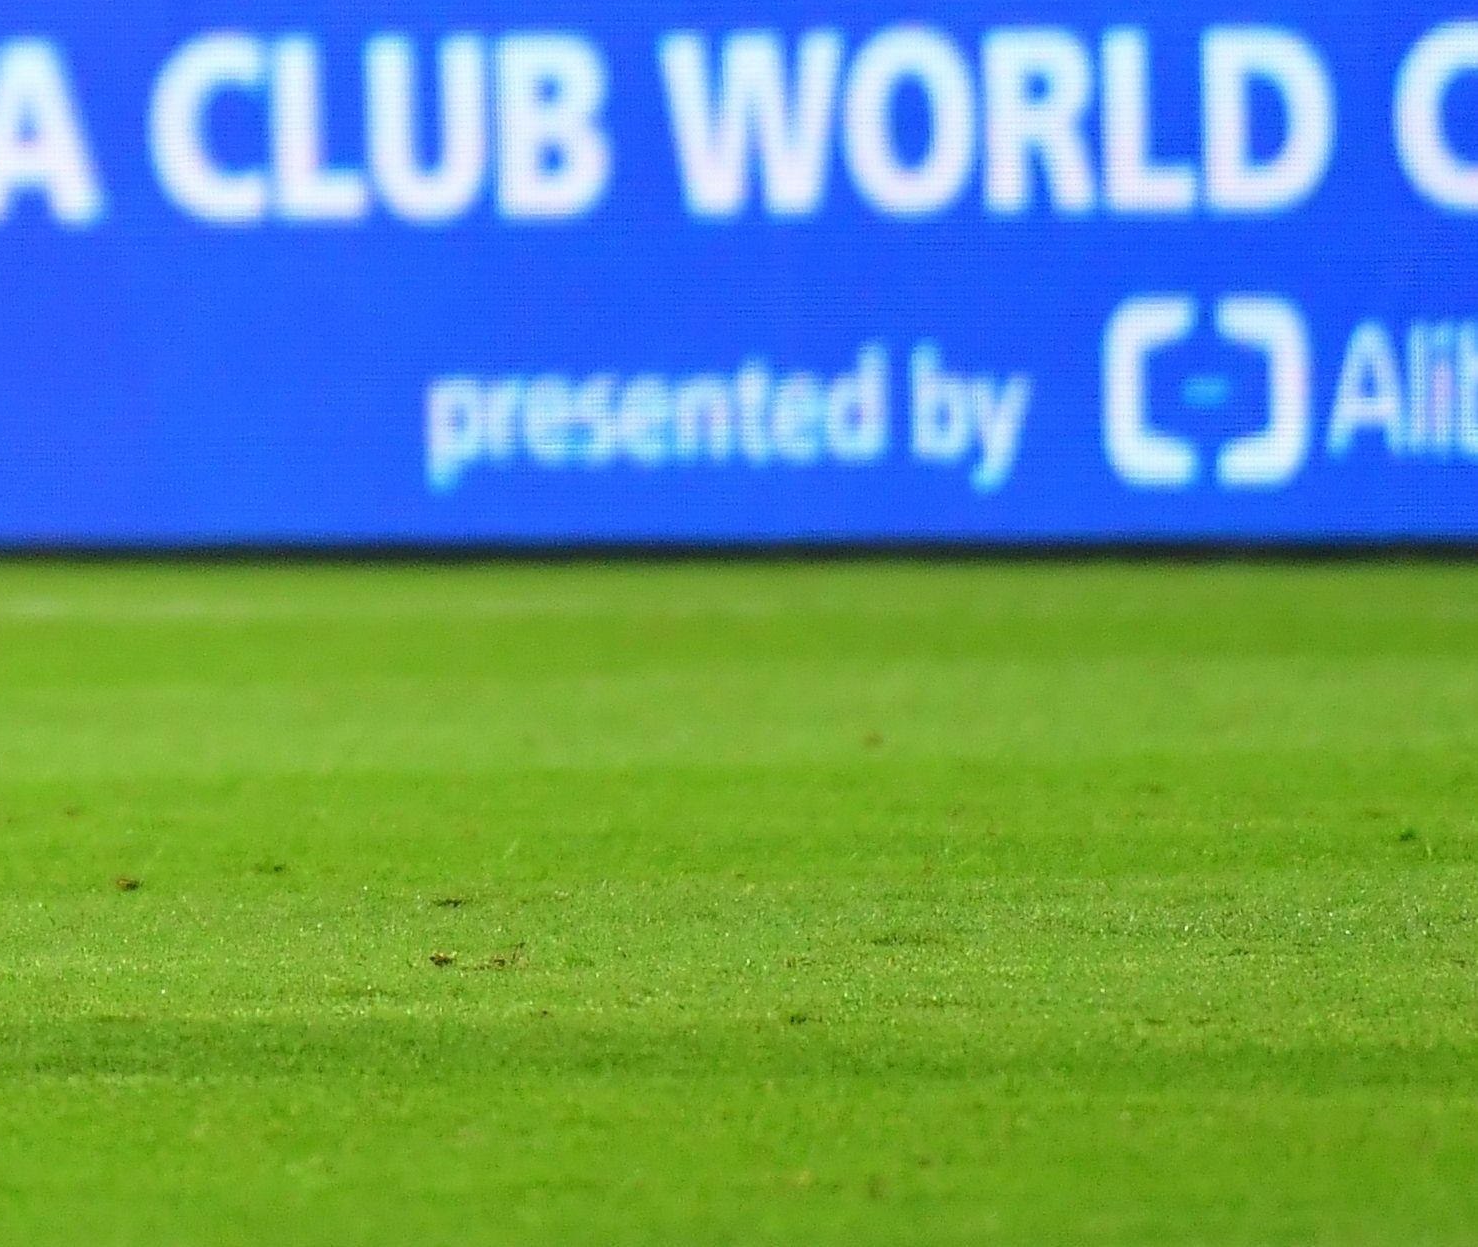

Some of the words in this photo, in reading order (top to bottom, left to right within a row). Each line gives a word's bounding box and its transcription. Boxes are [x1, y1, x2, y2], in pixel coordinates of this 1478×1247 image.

[147, 29, 613, 227] CLUB
[656, 22, 1337, 220] WORLD
[425, 345, 890, 492] presented
[909, 342, 1033, 492] by
